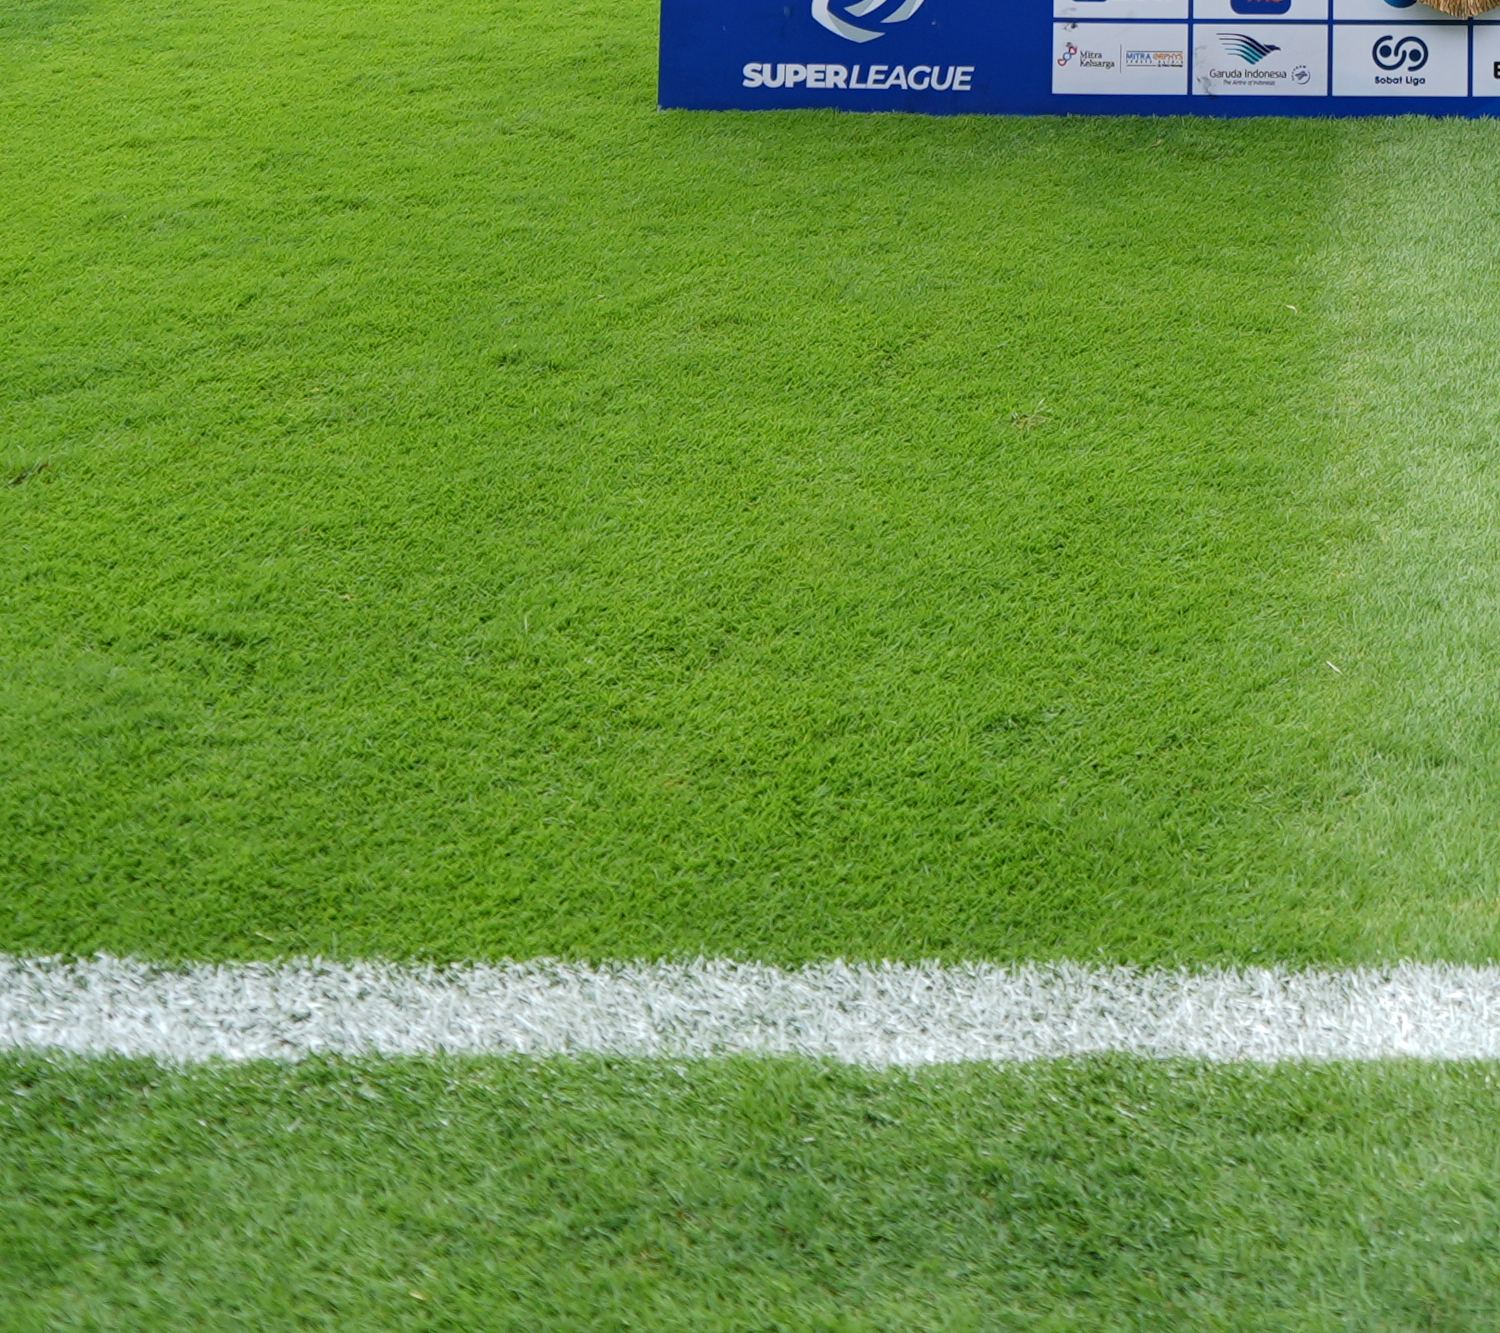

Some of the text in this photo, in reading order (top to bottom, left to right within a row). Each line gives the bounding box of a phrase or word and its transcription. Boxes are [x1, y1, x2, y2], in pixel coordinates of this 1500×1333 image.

[1080, 50, 1103, 59] Mitra
[1126, 52, 1151, 60] MITRA
[1080, 59, 1115, 70] Keluarga
[1209, 68, 1287, 79] Garuda Indonesia
[1375, 76, 1426, 88] Sobat Liga
